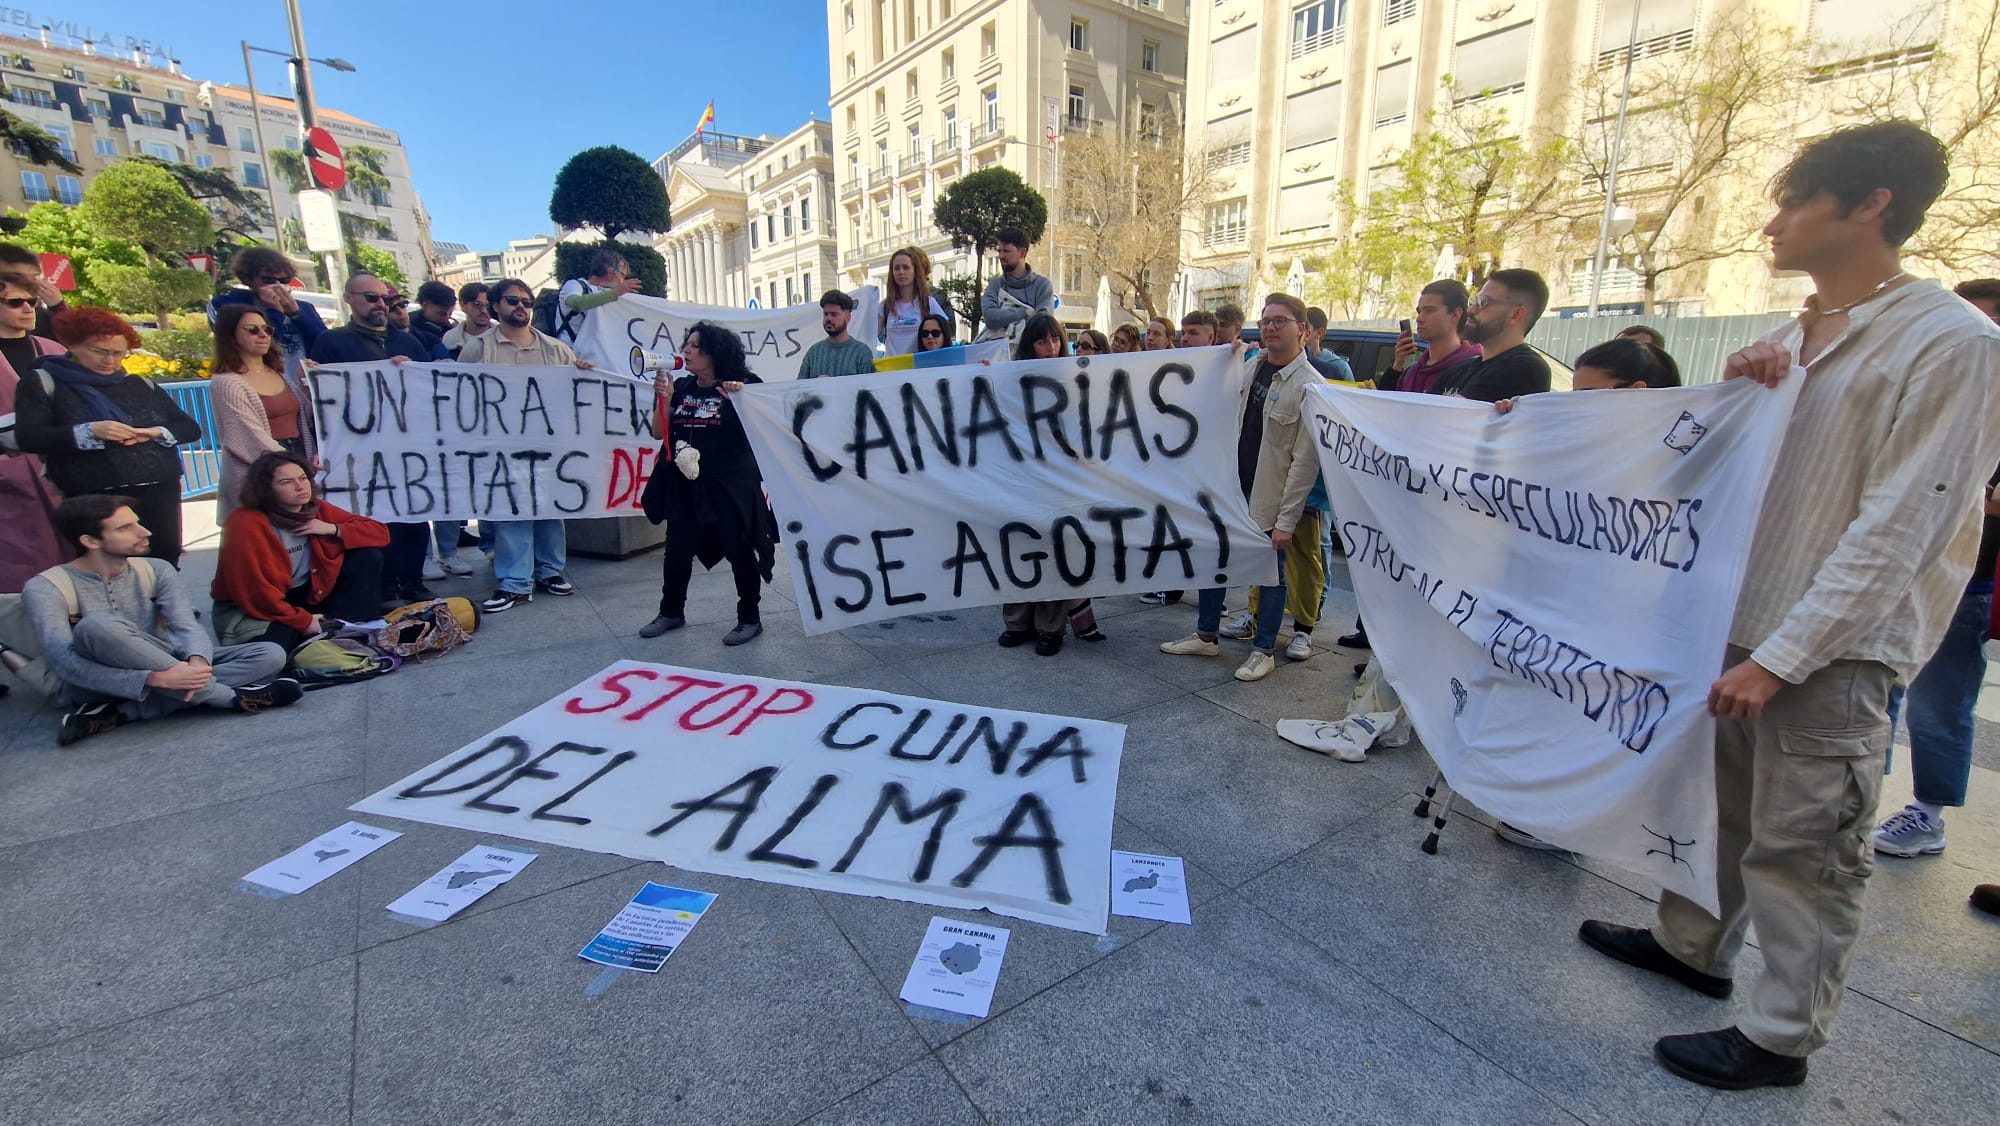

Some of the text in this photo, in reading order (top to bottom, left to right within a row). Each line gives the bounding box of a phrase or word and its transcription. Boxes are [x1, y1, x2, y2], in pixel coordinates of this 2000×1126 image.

[48, 16, 114, 47] VILLA
[125, 35, 173, 59] REAL
[48, 258, 69, 285] Cerrado
[627, 317, 802, 358] CAIAS
[309, 369, 408, 440] FUN
[431, 368, 508, 436] FOR
[520, 376, 554, 436] A
[605, 447, 660, 512] DE
[942, 490, 1230, 598] AGOTA!
[1429, 463, 1448, 502] Y
[1452, 467, 1703, 573] ESPECULADORES
[1486, 608, 1669, 754] TERRITORIO
[563, 668, 1097, 783] STOP CUNA
[396, 733, 1074, 906] DEL ALMA
[943, 926, 996, 941] GRAN CANARIA
